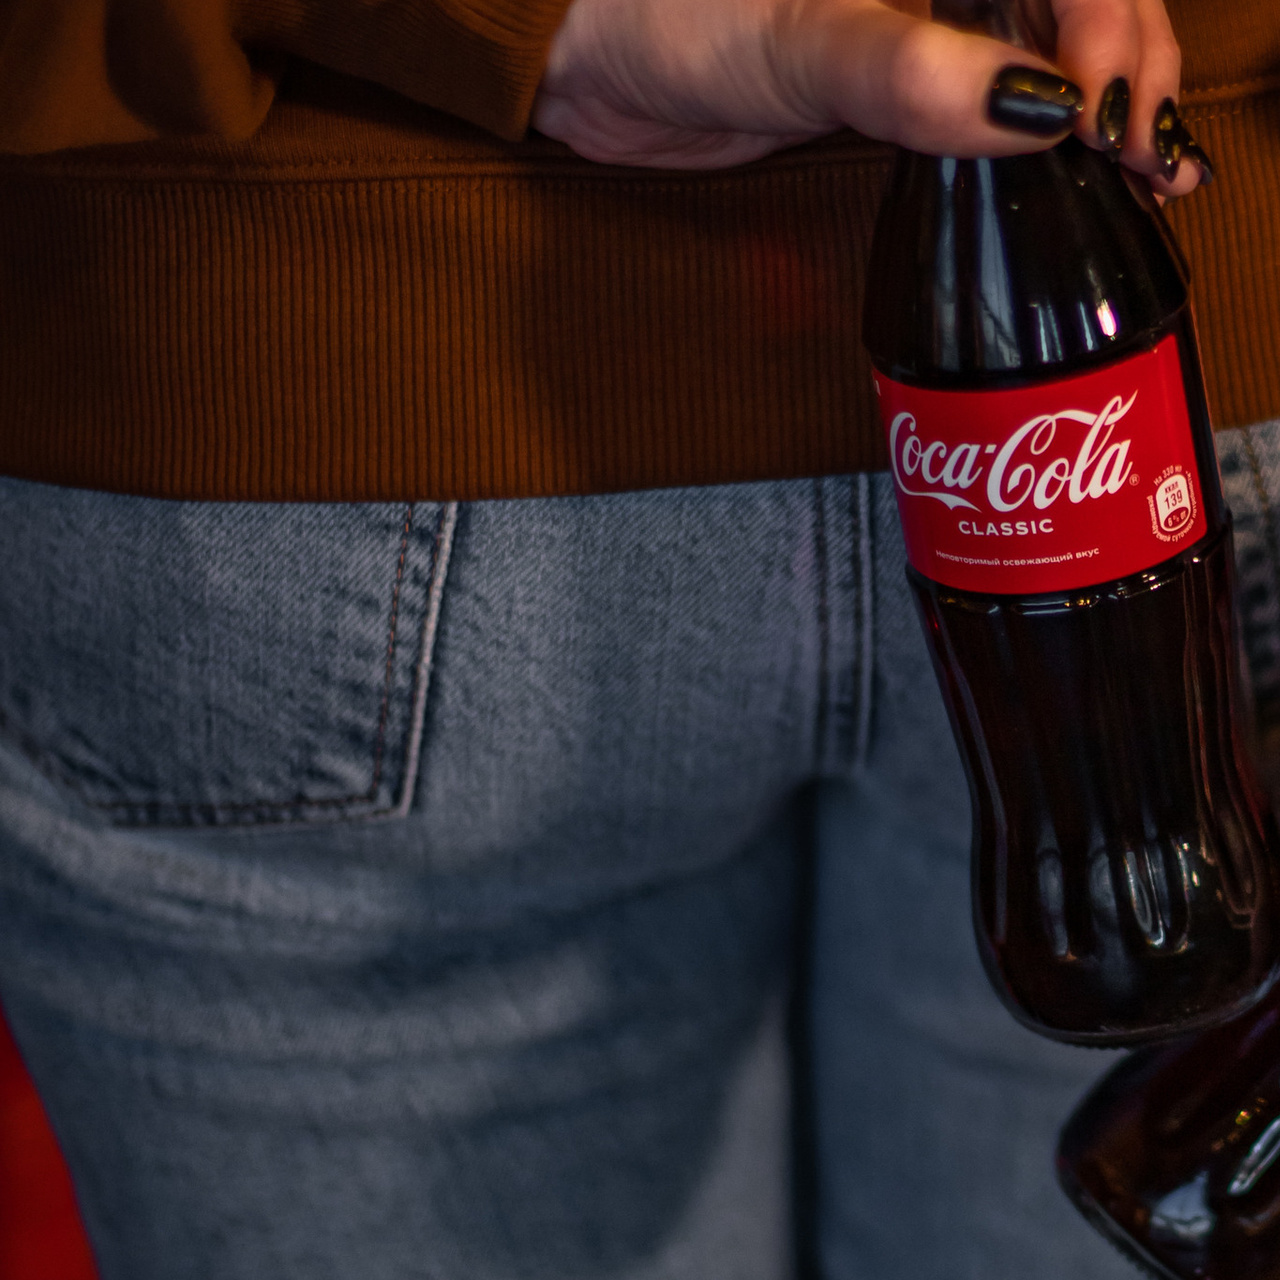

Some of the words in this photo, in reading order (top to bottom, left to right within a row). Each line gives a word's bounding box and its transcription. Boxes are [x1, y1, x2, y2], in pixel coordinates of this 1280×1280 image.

[889, 389, 1139, 512] Coca-Cola
[1164, 489, 1183, 510] 139
[958, 518, 1055, 536] CLASSIC
[935, 550, 1001, 566] Неповторимый
[1003, 552, 1073, 566] освежающий
[1075, 548, 1100, 559] вкус
